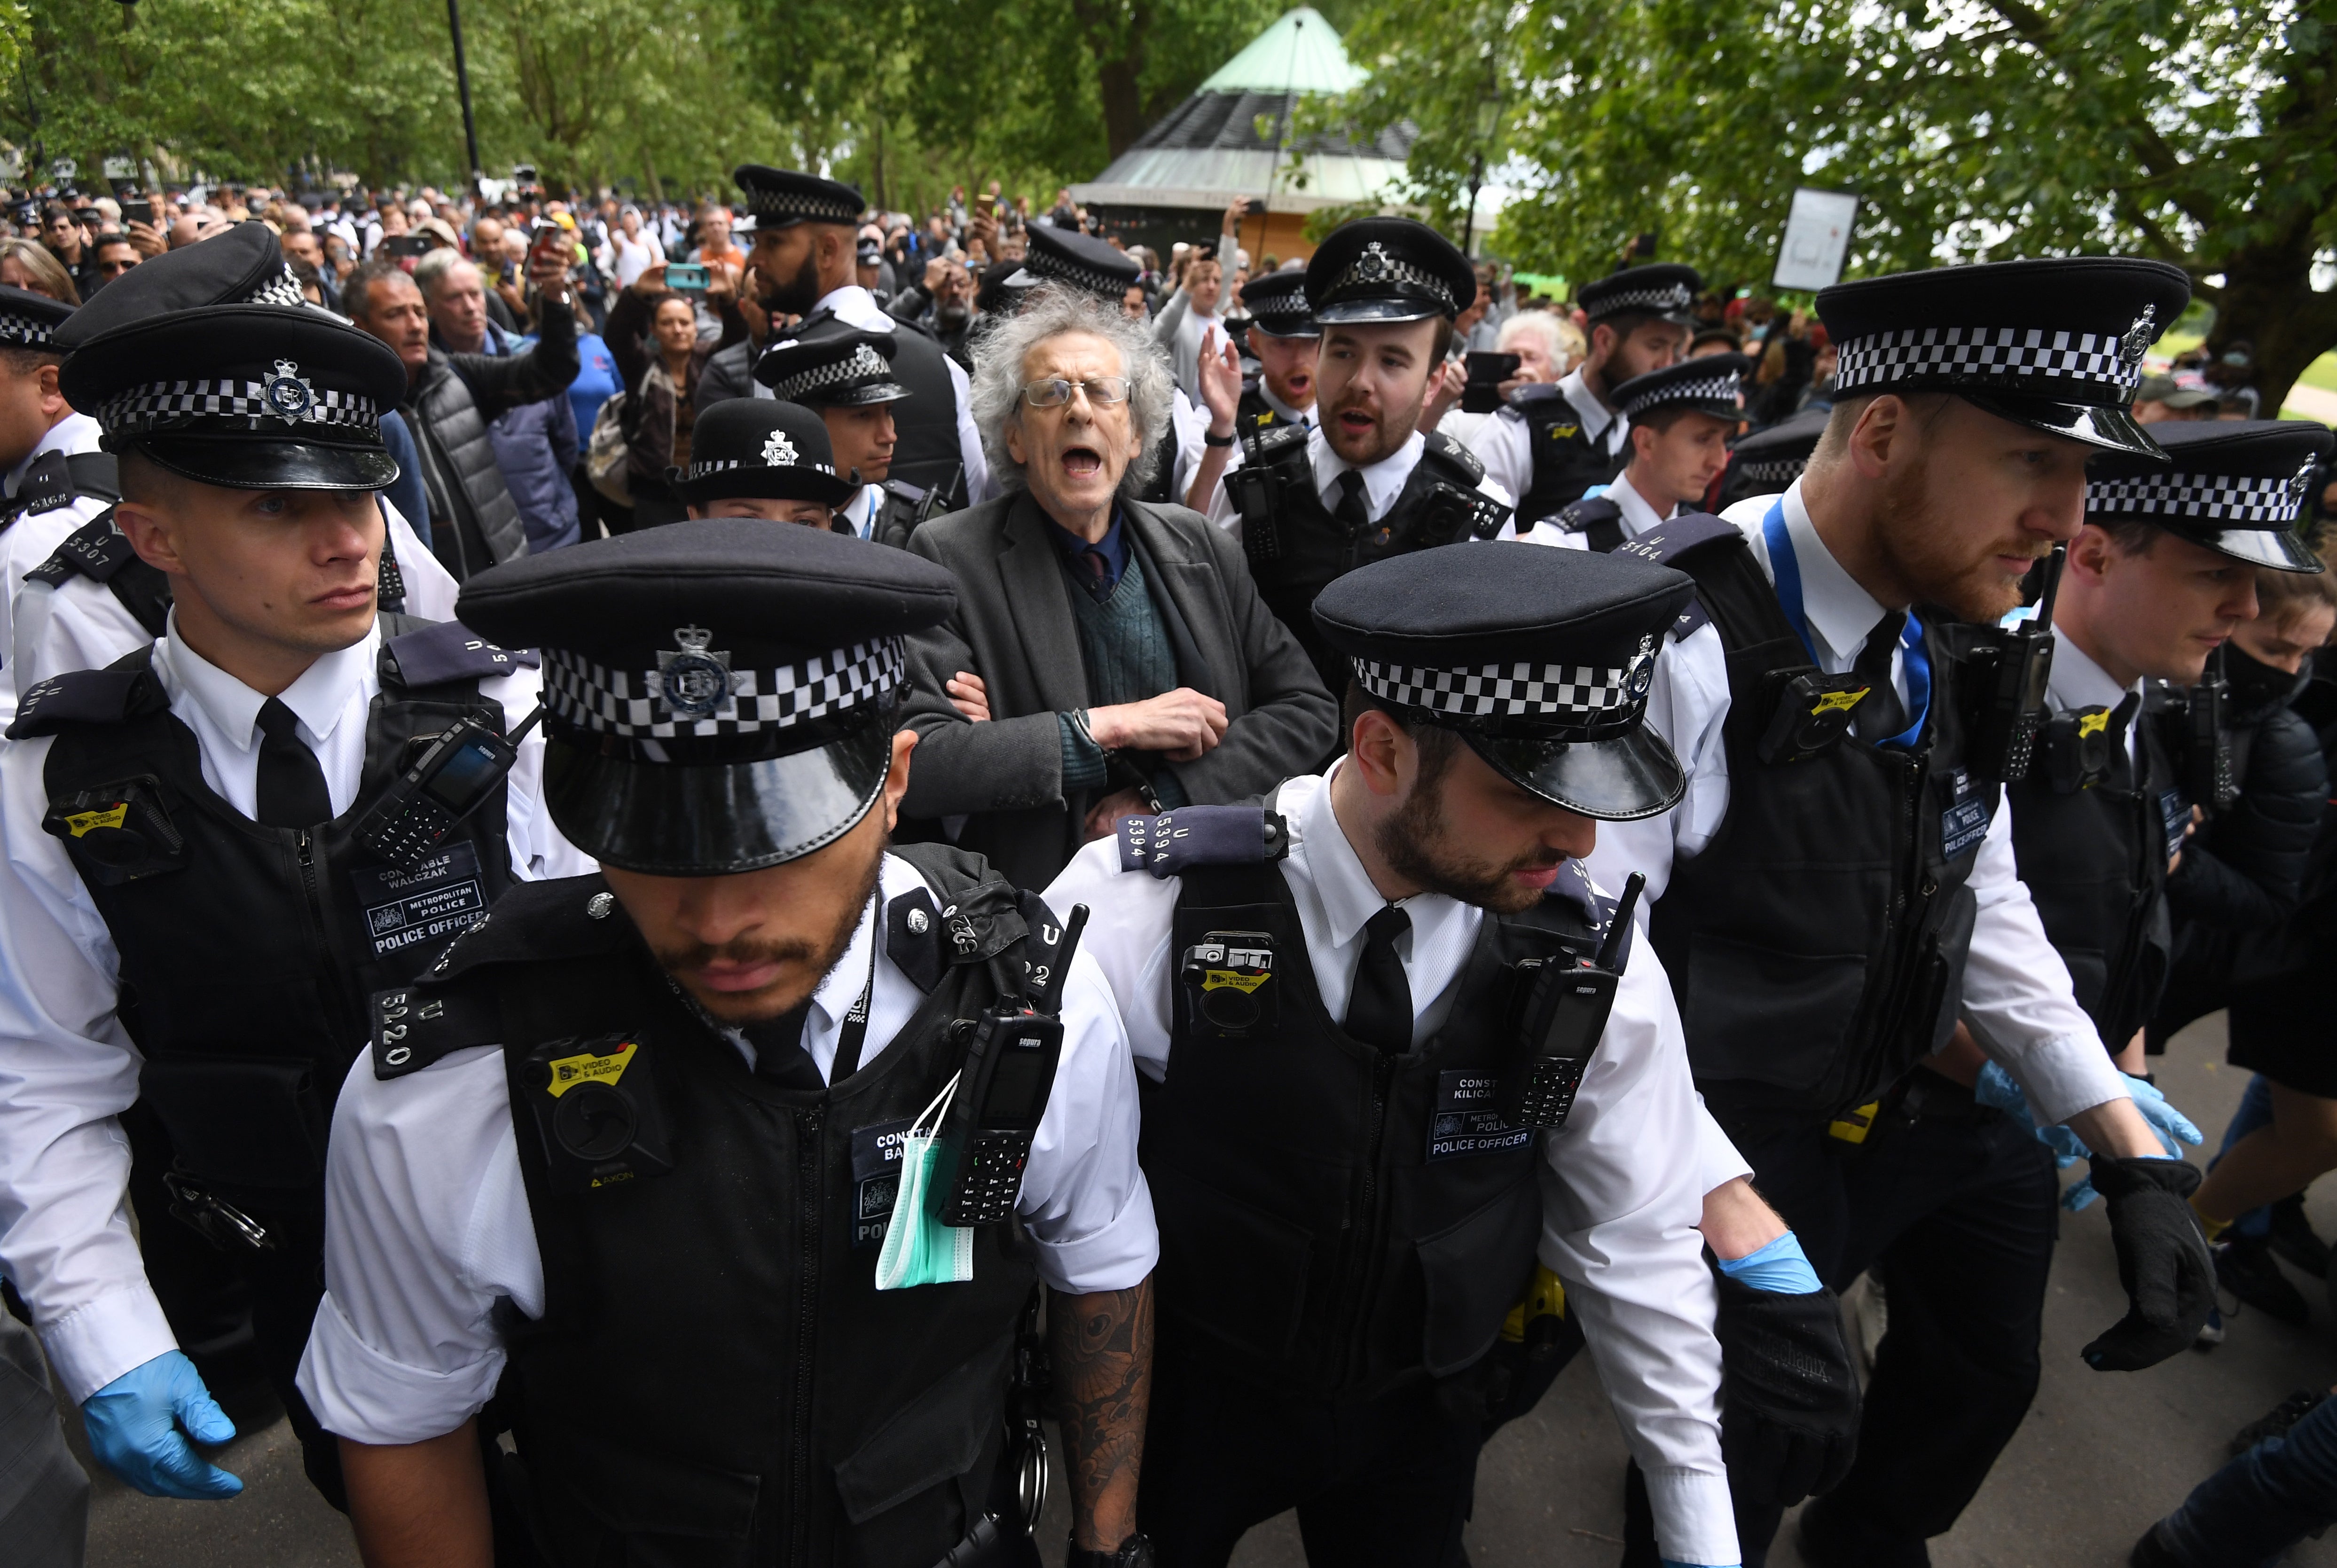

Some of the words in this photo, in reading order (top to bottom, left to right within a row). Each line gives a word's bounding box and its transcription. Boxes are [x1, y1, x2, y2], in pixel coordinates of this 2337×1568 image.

[95, 536, 109, 547] U
[1649, 536, 1665, 545] U
[71, 537, 110, 565] 5307
[1622, 541, 1663, 561] 5104
[465, 641, 483, 651] U
[46, 687, 63, 696] U
[478, 745, 496, 760] sepura
[89, 813, 111, 821] VIDEO
[100, 815, 121, 824] AUDIO
[1128, 820, 1146, 856] 5394
[1154, 817, 1172, 862] 5394
[1173, 828, 1189, 838] U
[1945, 835, 1965, 854] POLICE
[388, 867, 447, 889] WALCZAK
[410, 886, 472, 910] METROPOLITAN
[421, 898, 466, 917] POLICE
[376, 927, 426, 953] POLICE
[1043, 924, 1059, 945] U
[861, 979, 870, 1014] International
[418, 1000, 443, 1020] U
[382, 994, 411, 1065] 5220
[1019, 1038, 1041, 1047] sepura
[582, 1058, 611, 1069] VIDEO
[593, 1064, 622, 1076] AUDIO
[1433, 1139, 1475, 1154] POLICE
[1478, 1133, 1527, 1149] OFFICER
[604, 1171, 634, 1184] AXON
